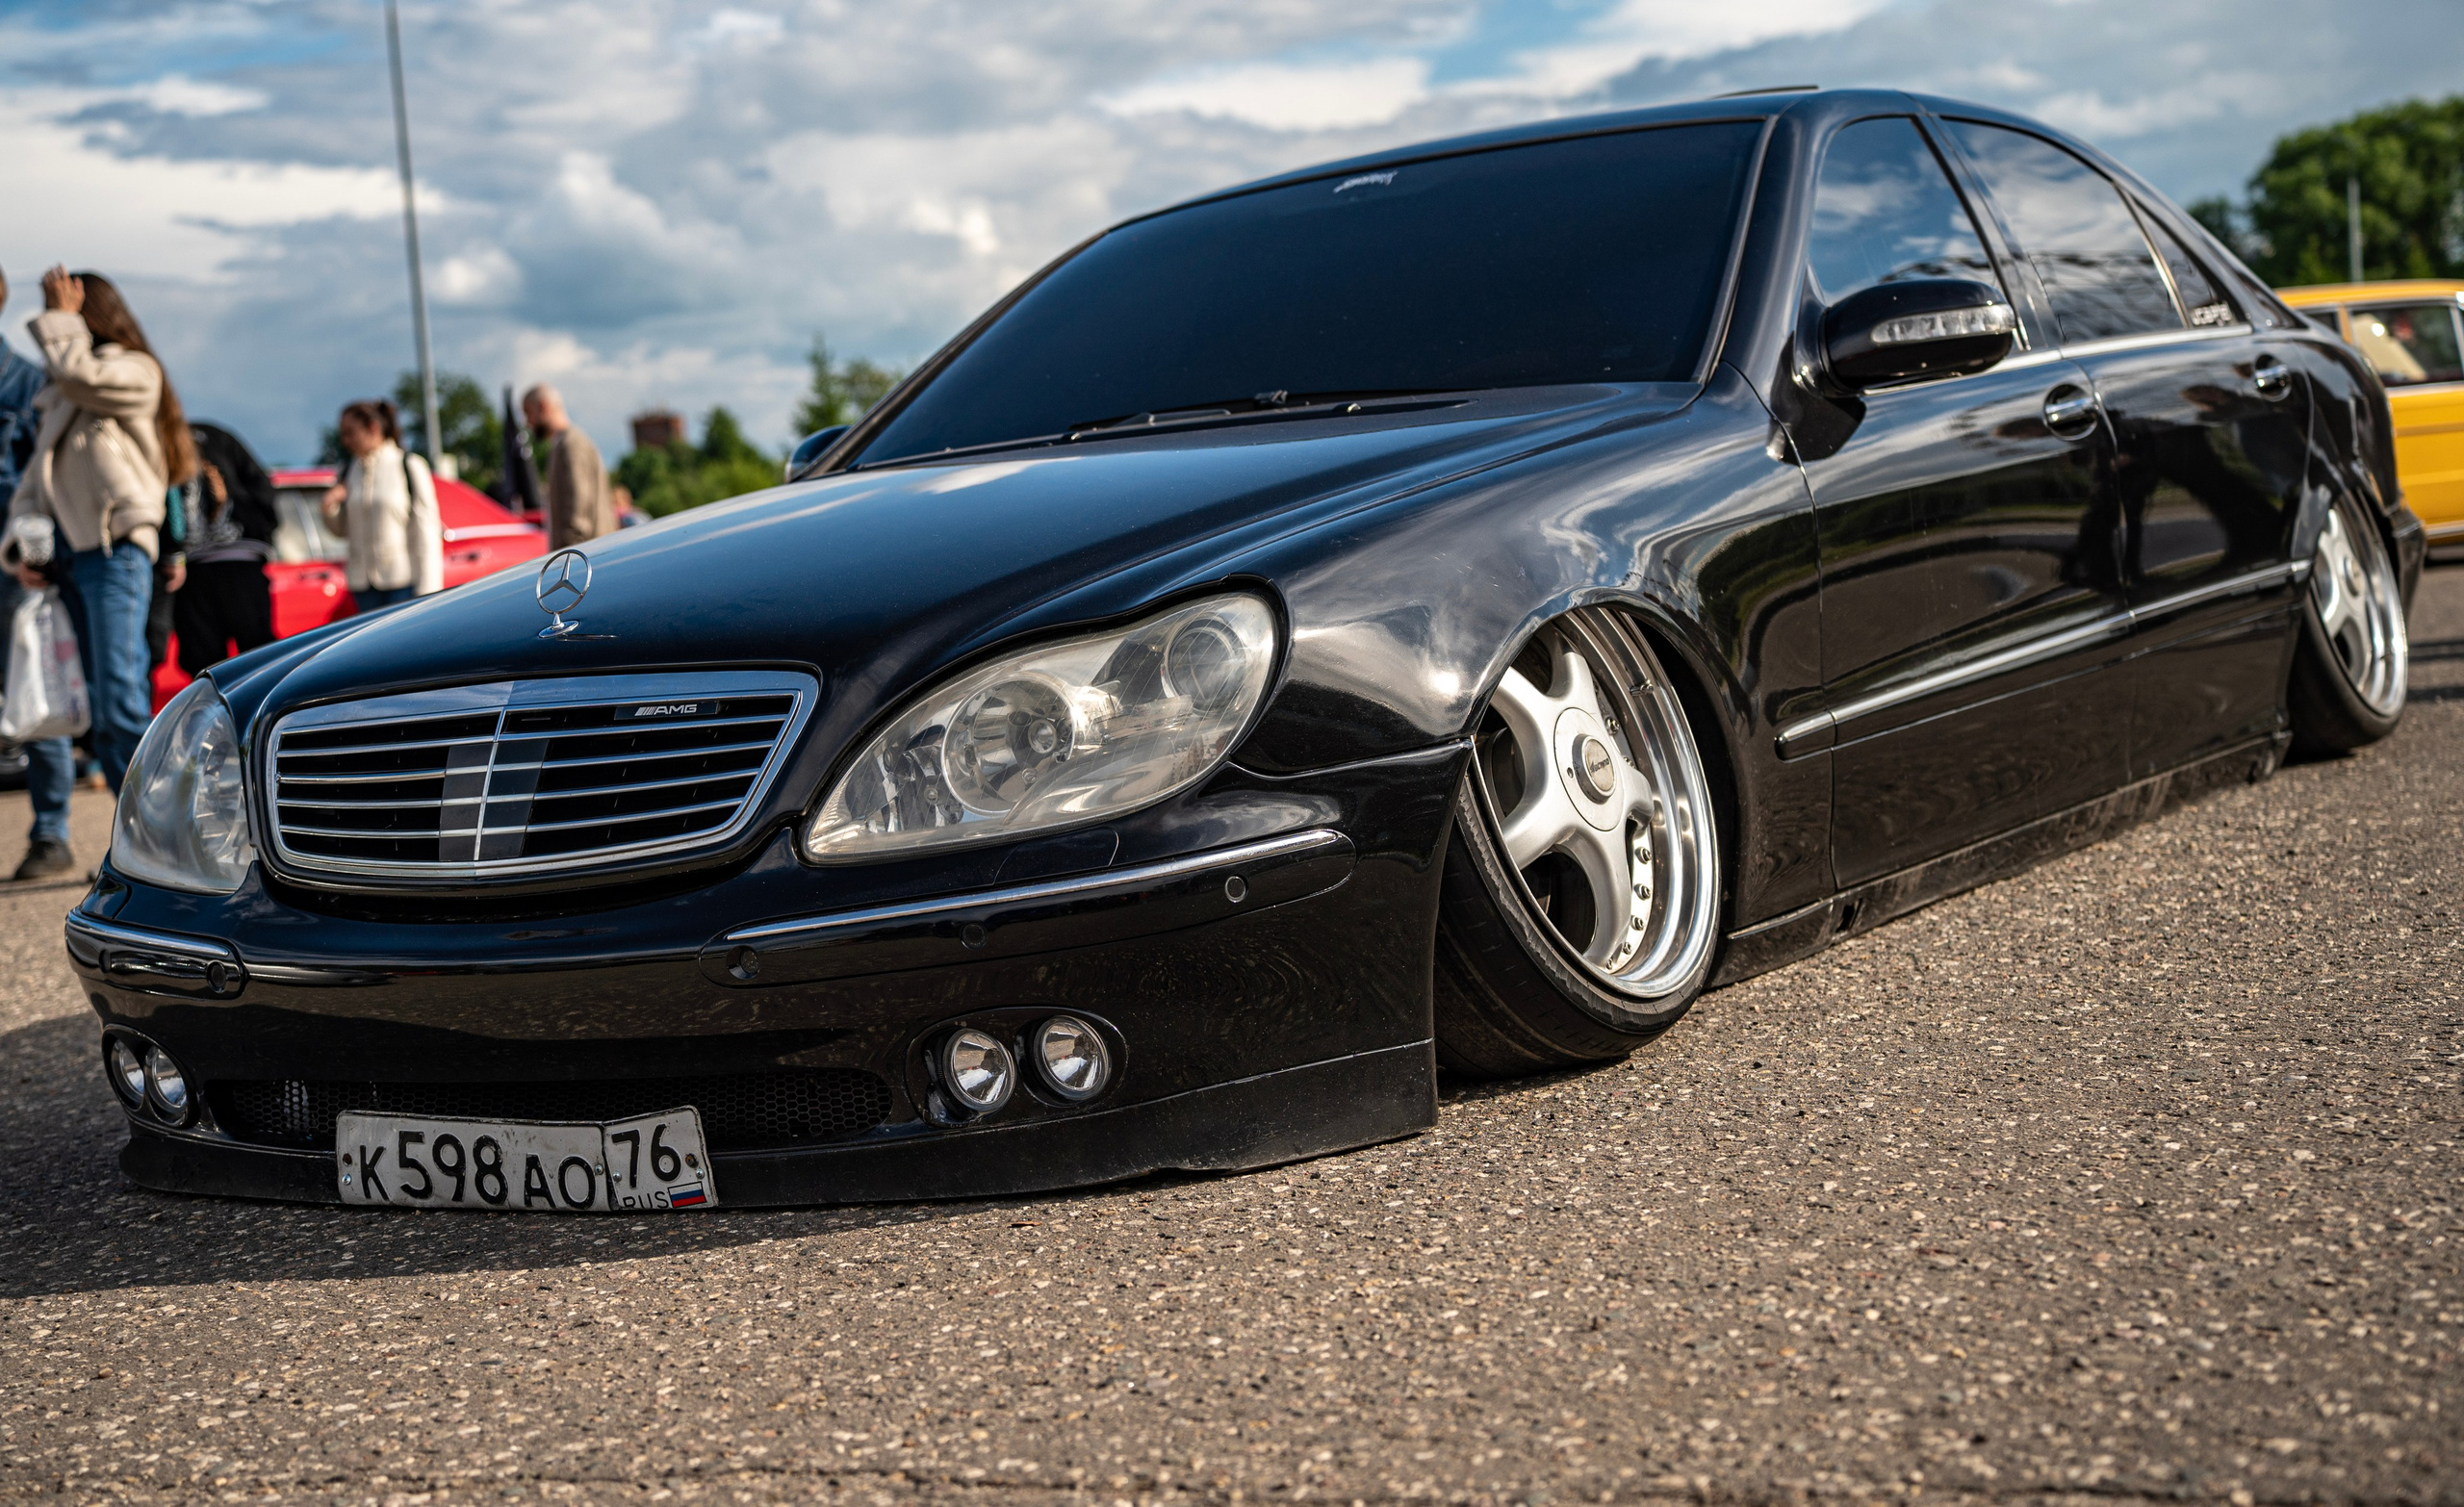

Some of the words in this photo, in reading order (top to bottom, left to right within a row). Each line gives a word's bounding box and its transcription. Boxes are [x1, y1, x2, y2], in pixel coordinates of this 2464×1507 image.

[654, 704, 698, 715] AMG
[611, 1123, 682, 1188] 76
[622, 1190, 670, 1209] RUS
